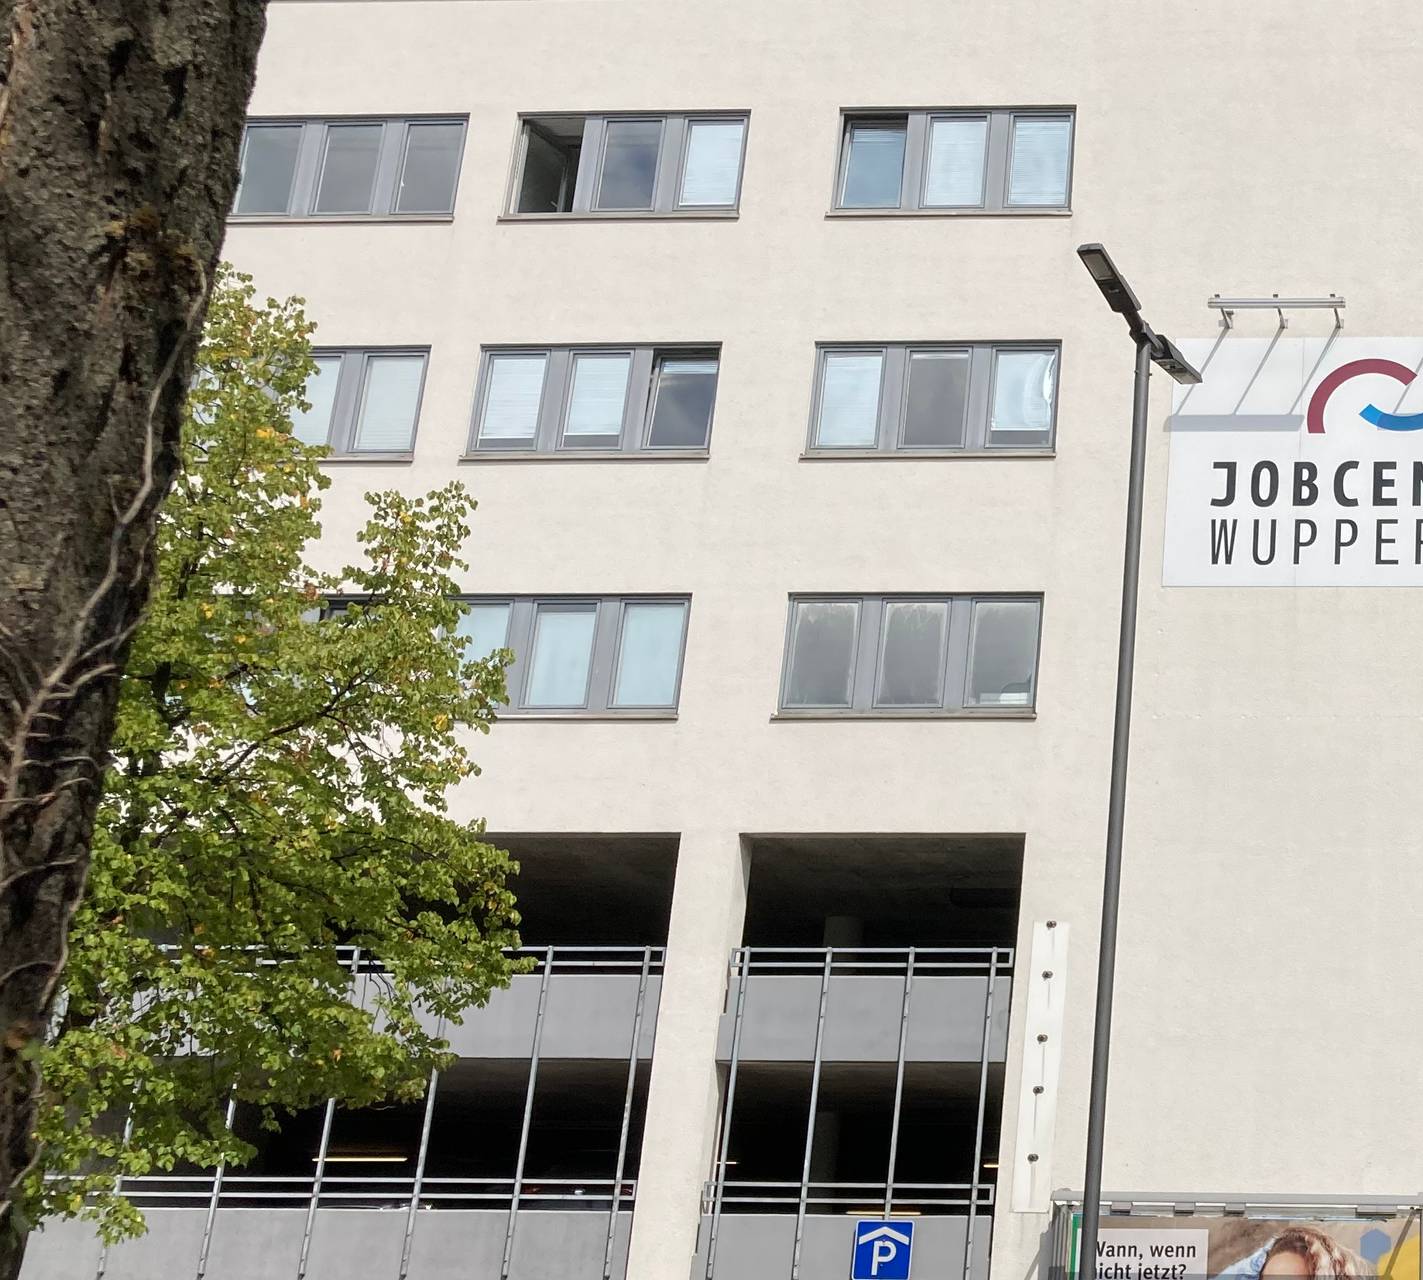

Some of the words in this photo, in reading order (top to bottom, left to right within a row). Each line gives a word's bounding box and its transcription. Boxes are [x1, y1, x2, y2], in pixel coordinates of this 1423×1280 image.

[871, 1240, 897, 1276] P
[1150, 1245, 1196, 1257] wenn
[1096, 1263, 1131, 1280] icht
[1138, 1263, 1187, 1280] jetzt?
